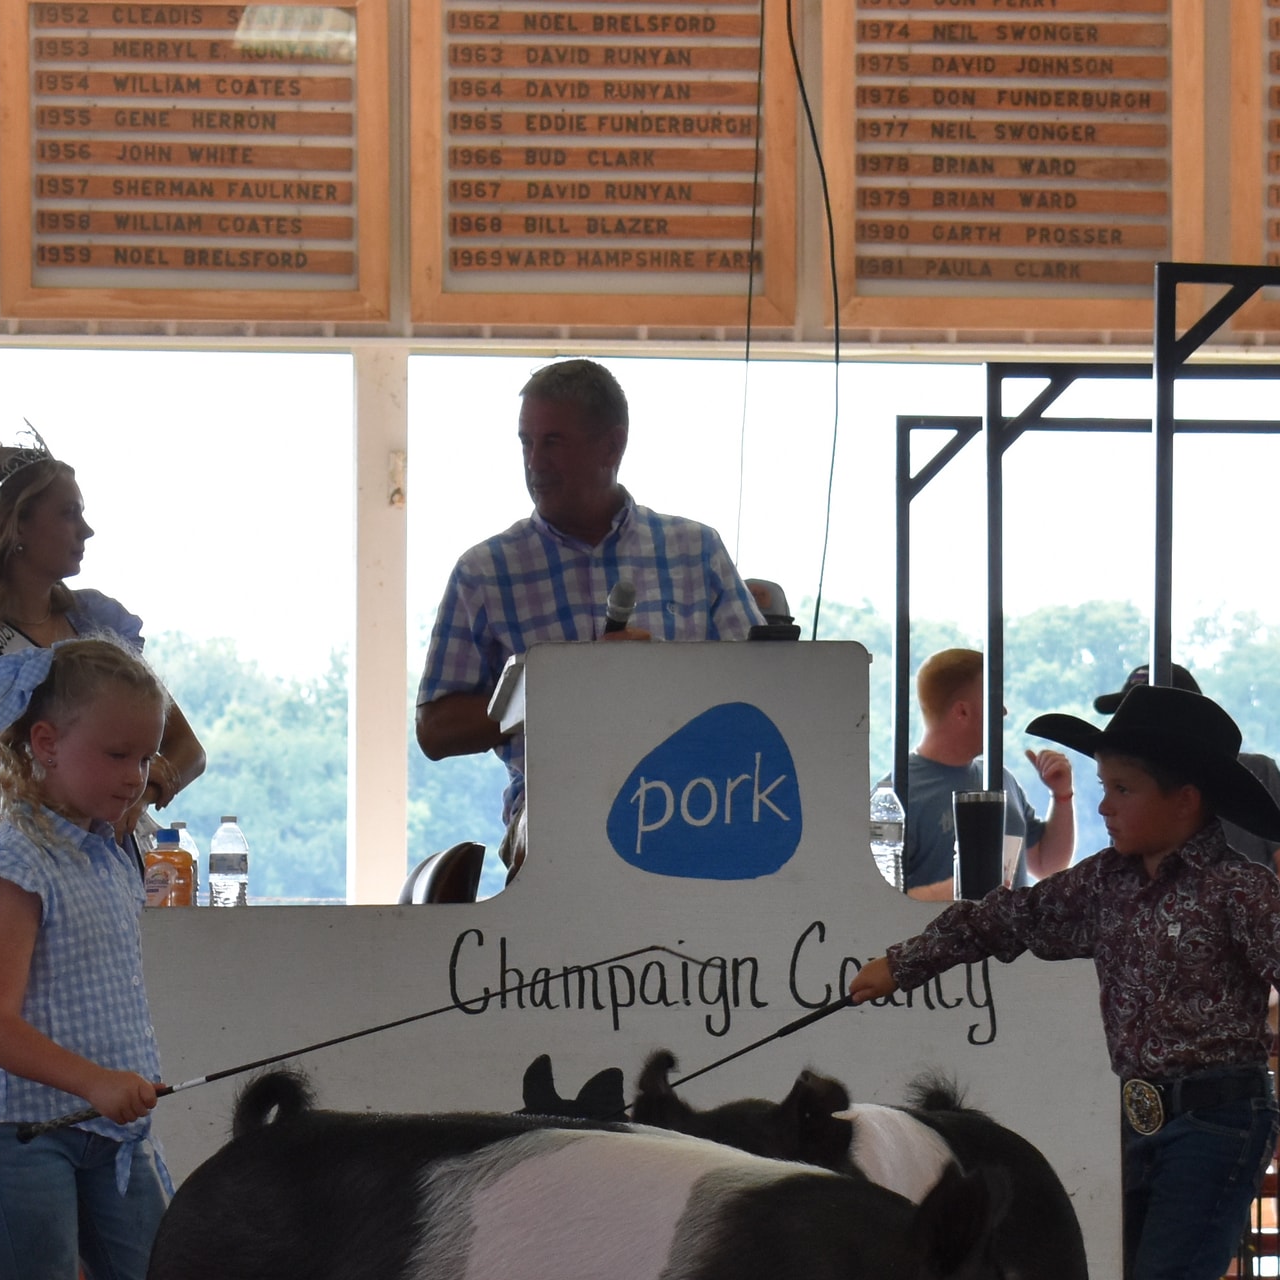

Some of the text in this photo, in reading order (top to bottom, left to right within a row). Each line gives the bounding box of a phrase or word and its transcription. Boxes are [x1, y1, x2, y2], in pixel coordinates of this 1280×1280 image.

[450, 14, 715, 32] 1962 NOEL BRELSFORD
[862, 24, 1098, 42] 1974 NEIL SWONGER
[452, 48, 691, 65] 1963 DAVID RUNYAN
[860, 57, 1113, 74] 1975 DAVID JOHNSON
[38, 75, 301, 95] 1954 WILLIAM COATES
[452, 81, 690, 99] 1964 DAVID RUNYAN
[861, 90, 1150, 107] 1976 DON FUNDERBURGH
[40, 109, 276, 129] 1955 GENE HERRON
[452, 115, 751, 133] 1965 EDDIE FUNDERBURGH
[862, 123, 1096, 140] 1977 NEIL SWONGER
[40, 143, 253, 163] 1956 JOHN WHITE
[452, 150, 655, 166] 1966 BUD CLARK
[39, 178, 337, 199] 1957 SHERMAN FAULKNER
[452, 183, 692, 201] 1967 DAVID RUNYAN
[862, 191, 1077, 208] 1979 BRIAN WARD
[39, 213, 302, 233] 1958 WILLIAM COATES
[452, 217, 668, 234] 1968 BILL BLAZER
[38, 246, 308, 268] 1959 NOEL BRELSFORD
[452, 251, 762, 268] 1969 WARD HAMPSHIRE FARM
[630, 751, 791, 854] pork
[448, 927, 768, 1038] Champaign
